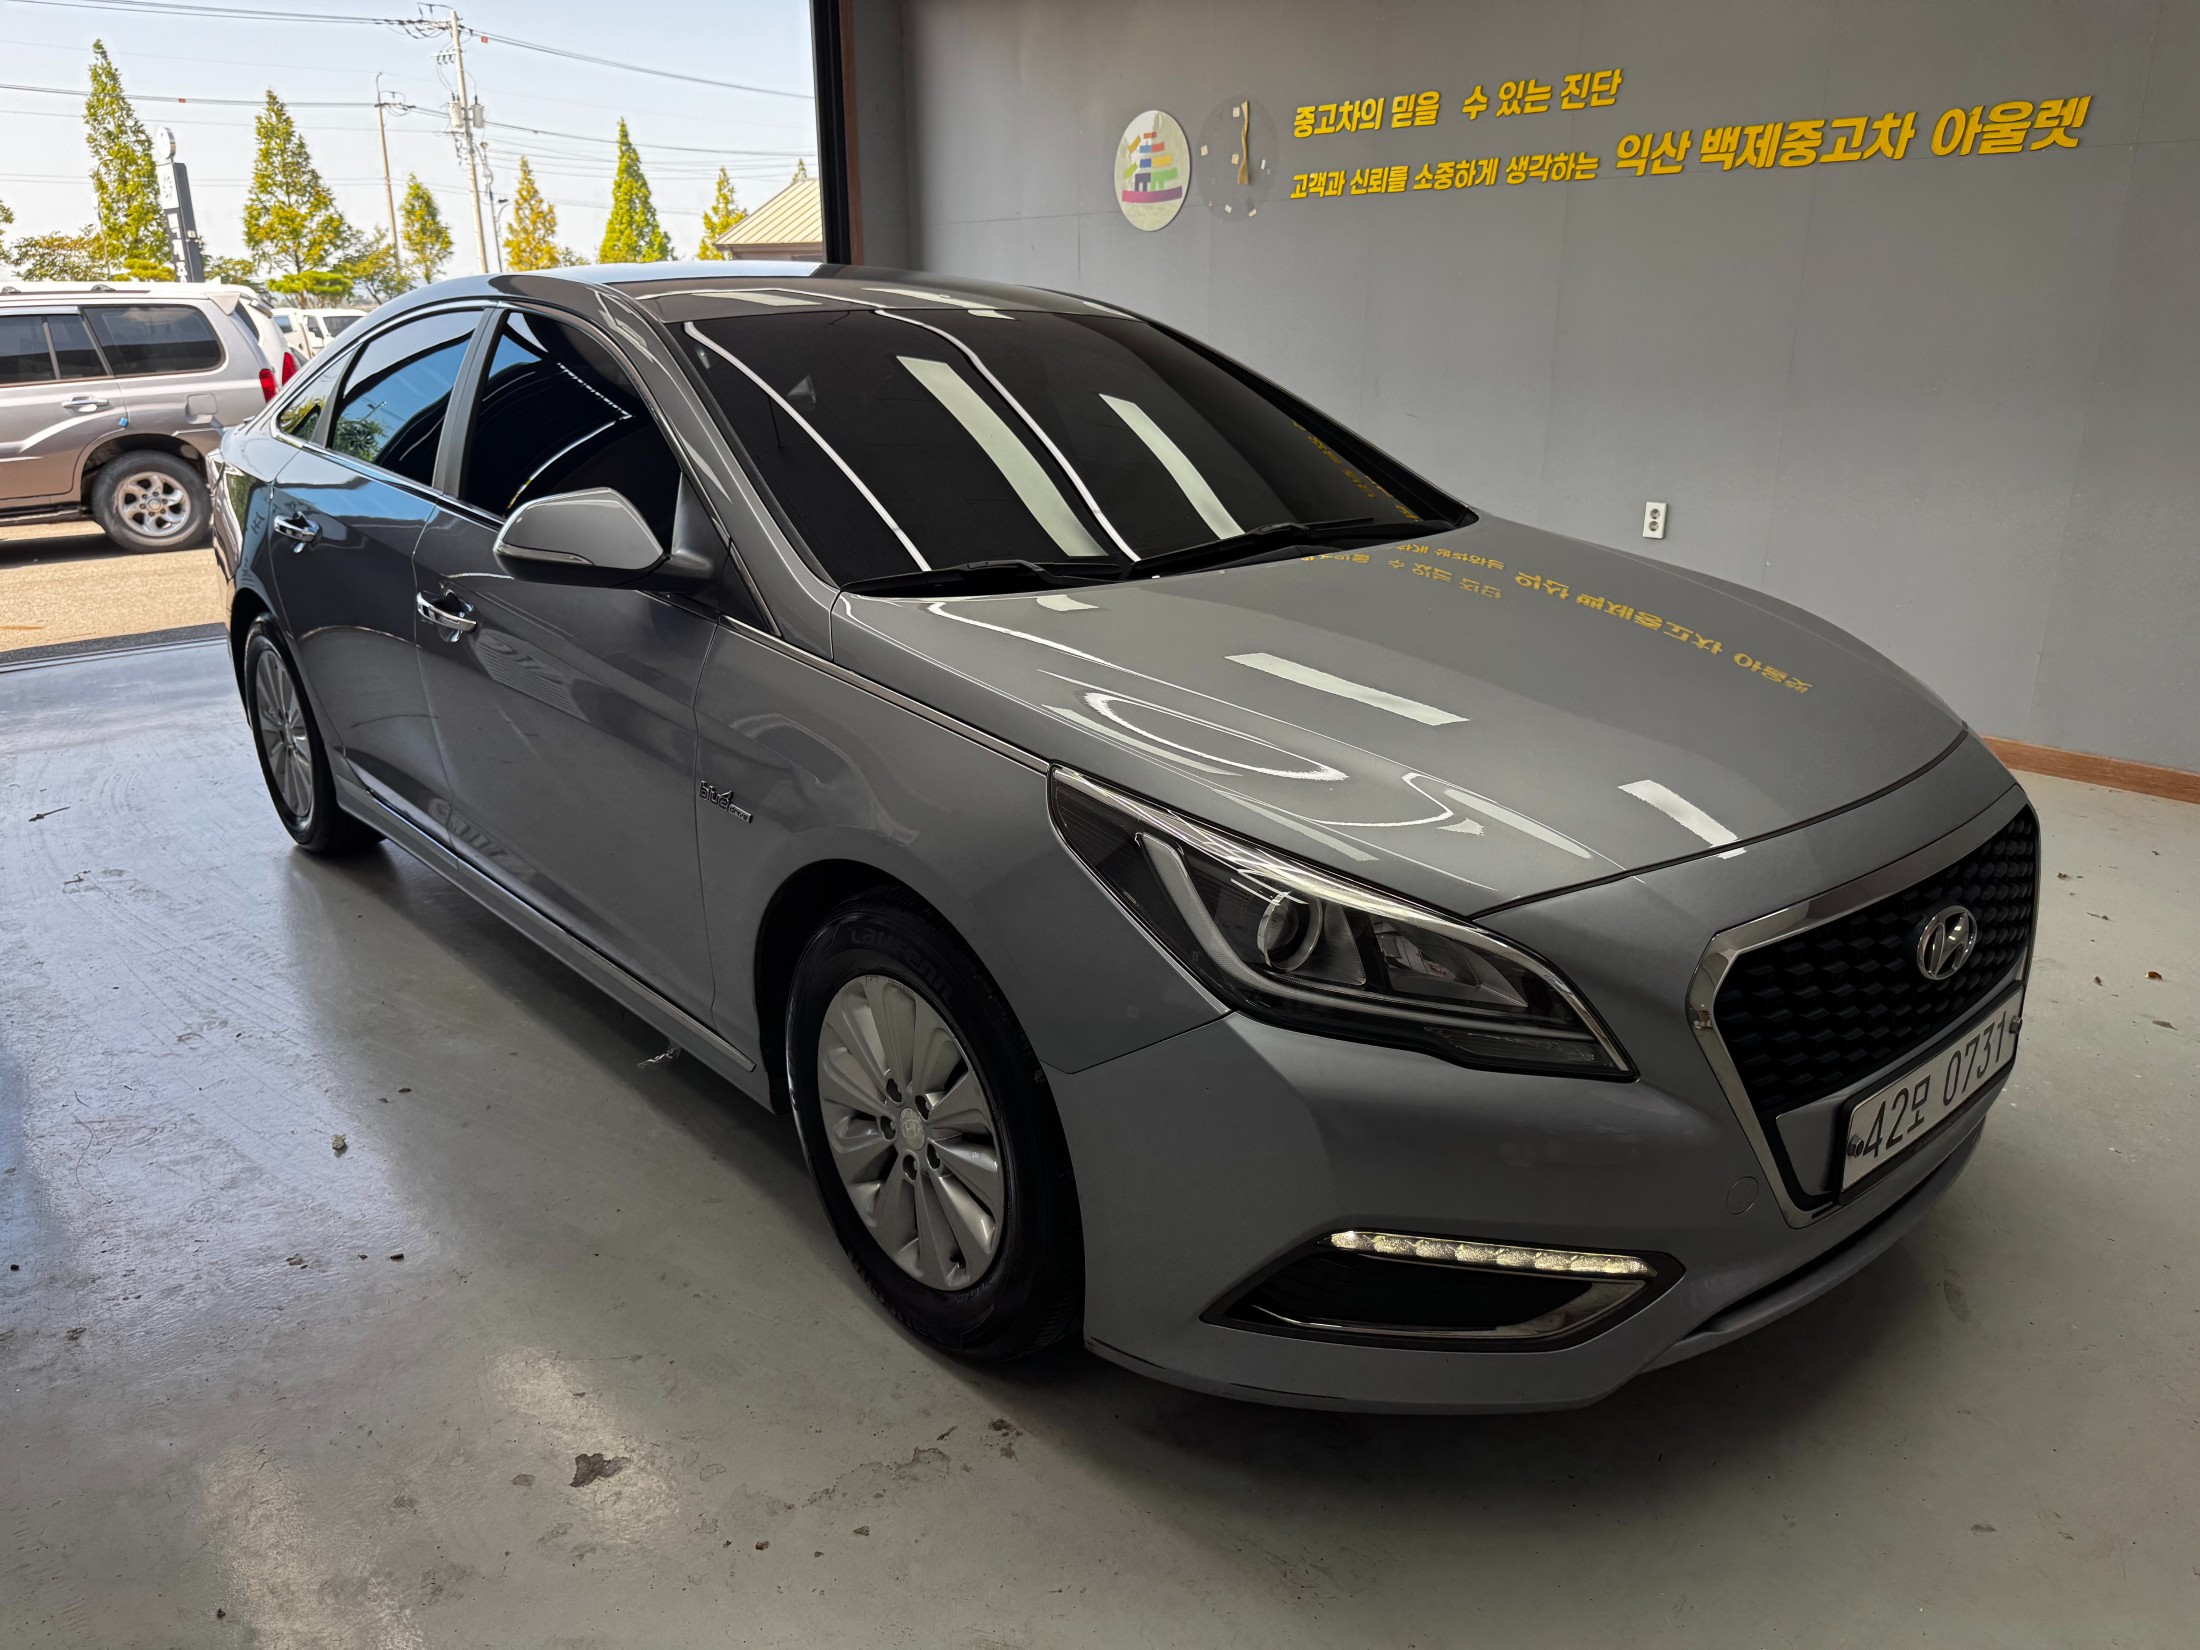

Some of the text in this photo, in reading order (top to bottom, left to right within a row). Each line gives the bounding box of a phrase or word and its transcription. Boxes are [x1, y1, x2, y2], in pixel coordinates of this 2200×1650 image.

[1289, 95, 2093, 200] 고객과 신뢰를 소중하게 생각하는 익산 백제중고차 아울렛
[1292, 67, 1624, 139] 중고차의 믿을 수 있는 진단
[1862, 1073, 1931, 1159] 42모
[1942, 1009, 2007, 1107] 0731
